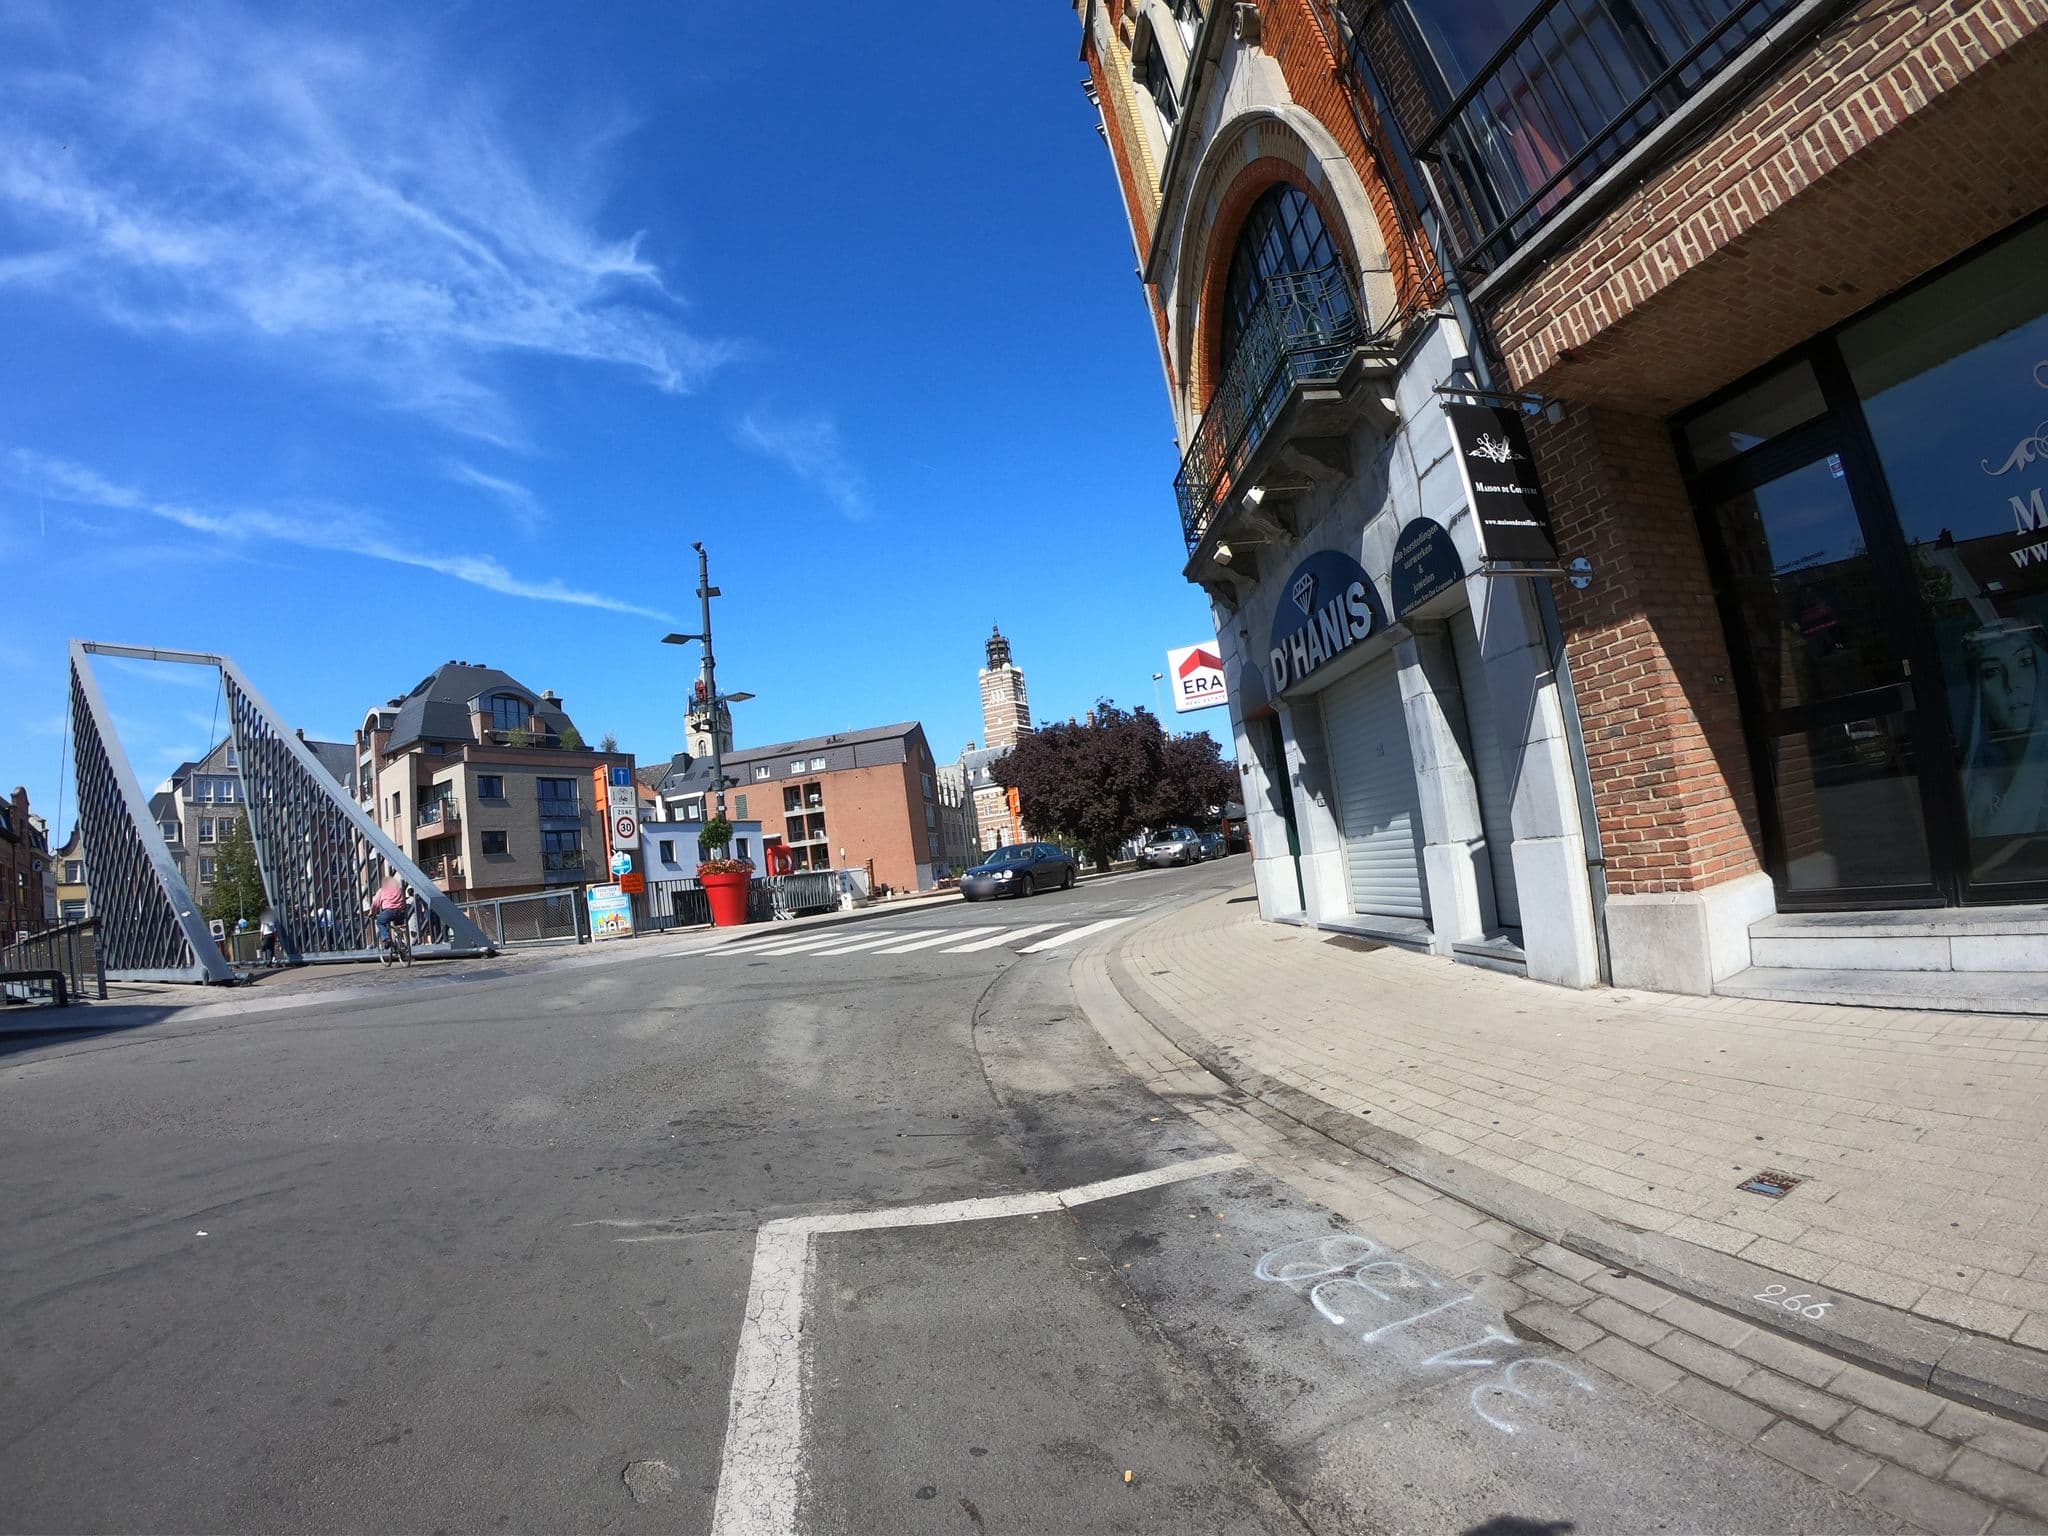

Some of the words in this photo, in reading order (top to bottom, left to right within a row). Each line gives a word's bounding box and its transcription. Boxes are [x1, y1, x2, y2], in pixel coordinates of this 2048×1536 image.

[1270, 581, 1372, 693] D'HANIS
[1183, 675, 1224, 694] ERA
[620, 823, 631, 832] 30
[1753, 1284, 1834, 1319] 266
